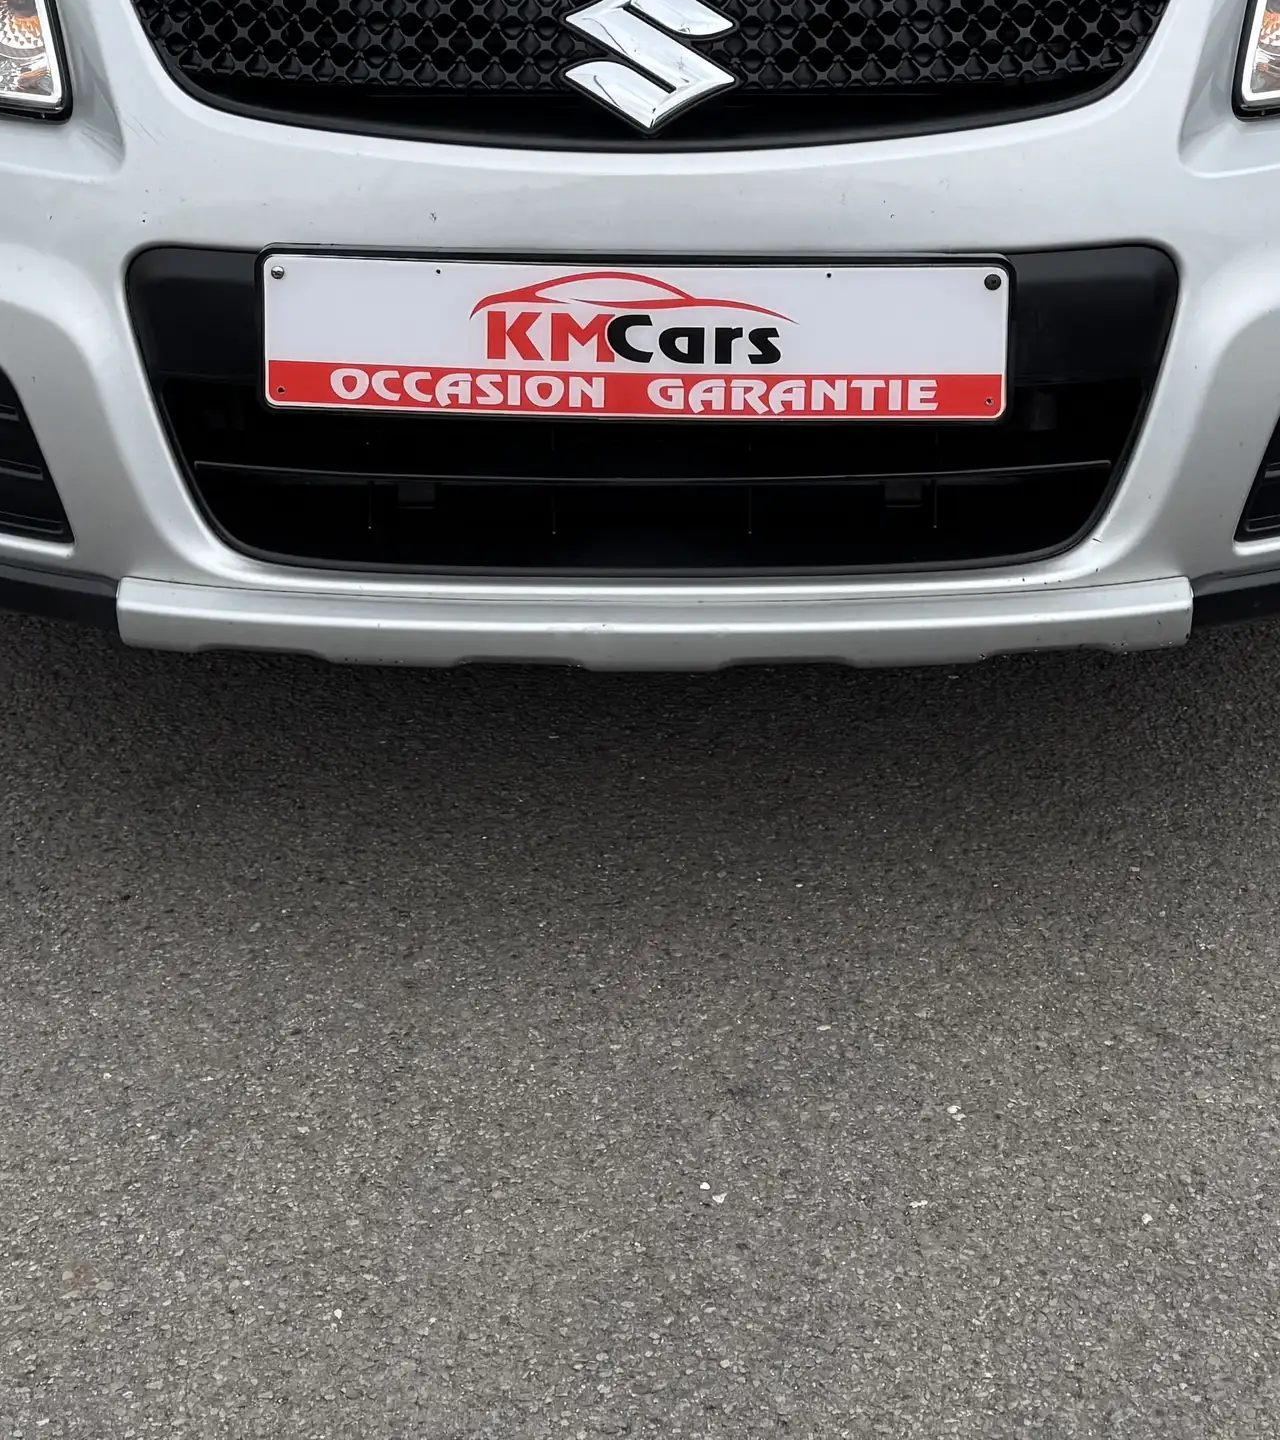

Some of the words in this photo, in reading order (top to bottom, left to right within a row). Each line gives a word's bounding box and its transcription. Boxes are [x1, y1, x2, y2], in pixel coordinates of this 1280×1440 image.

[486, 310, 782, 365] KMCars
[329, 368, 605, 408] OCCASION
[647, 378, 939, 415] GARANTIE
